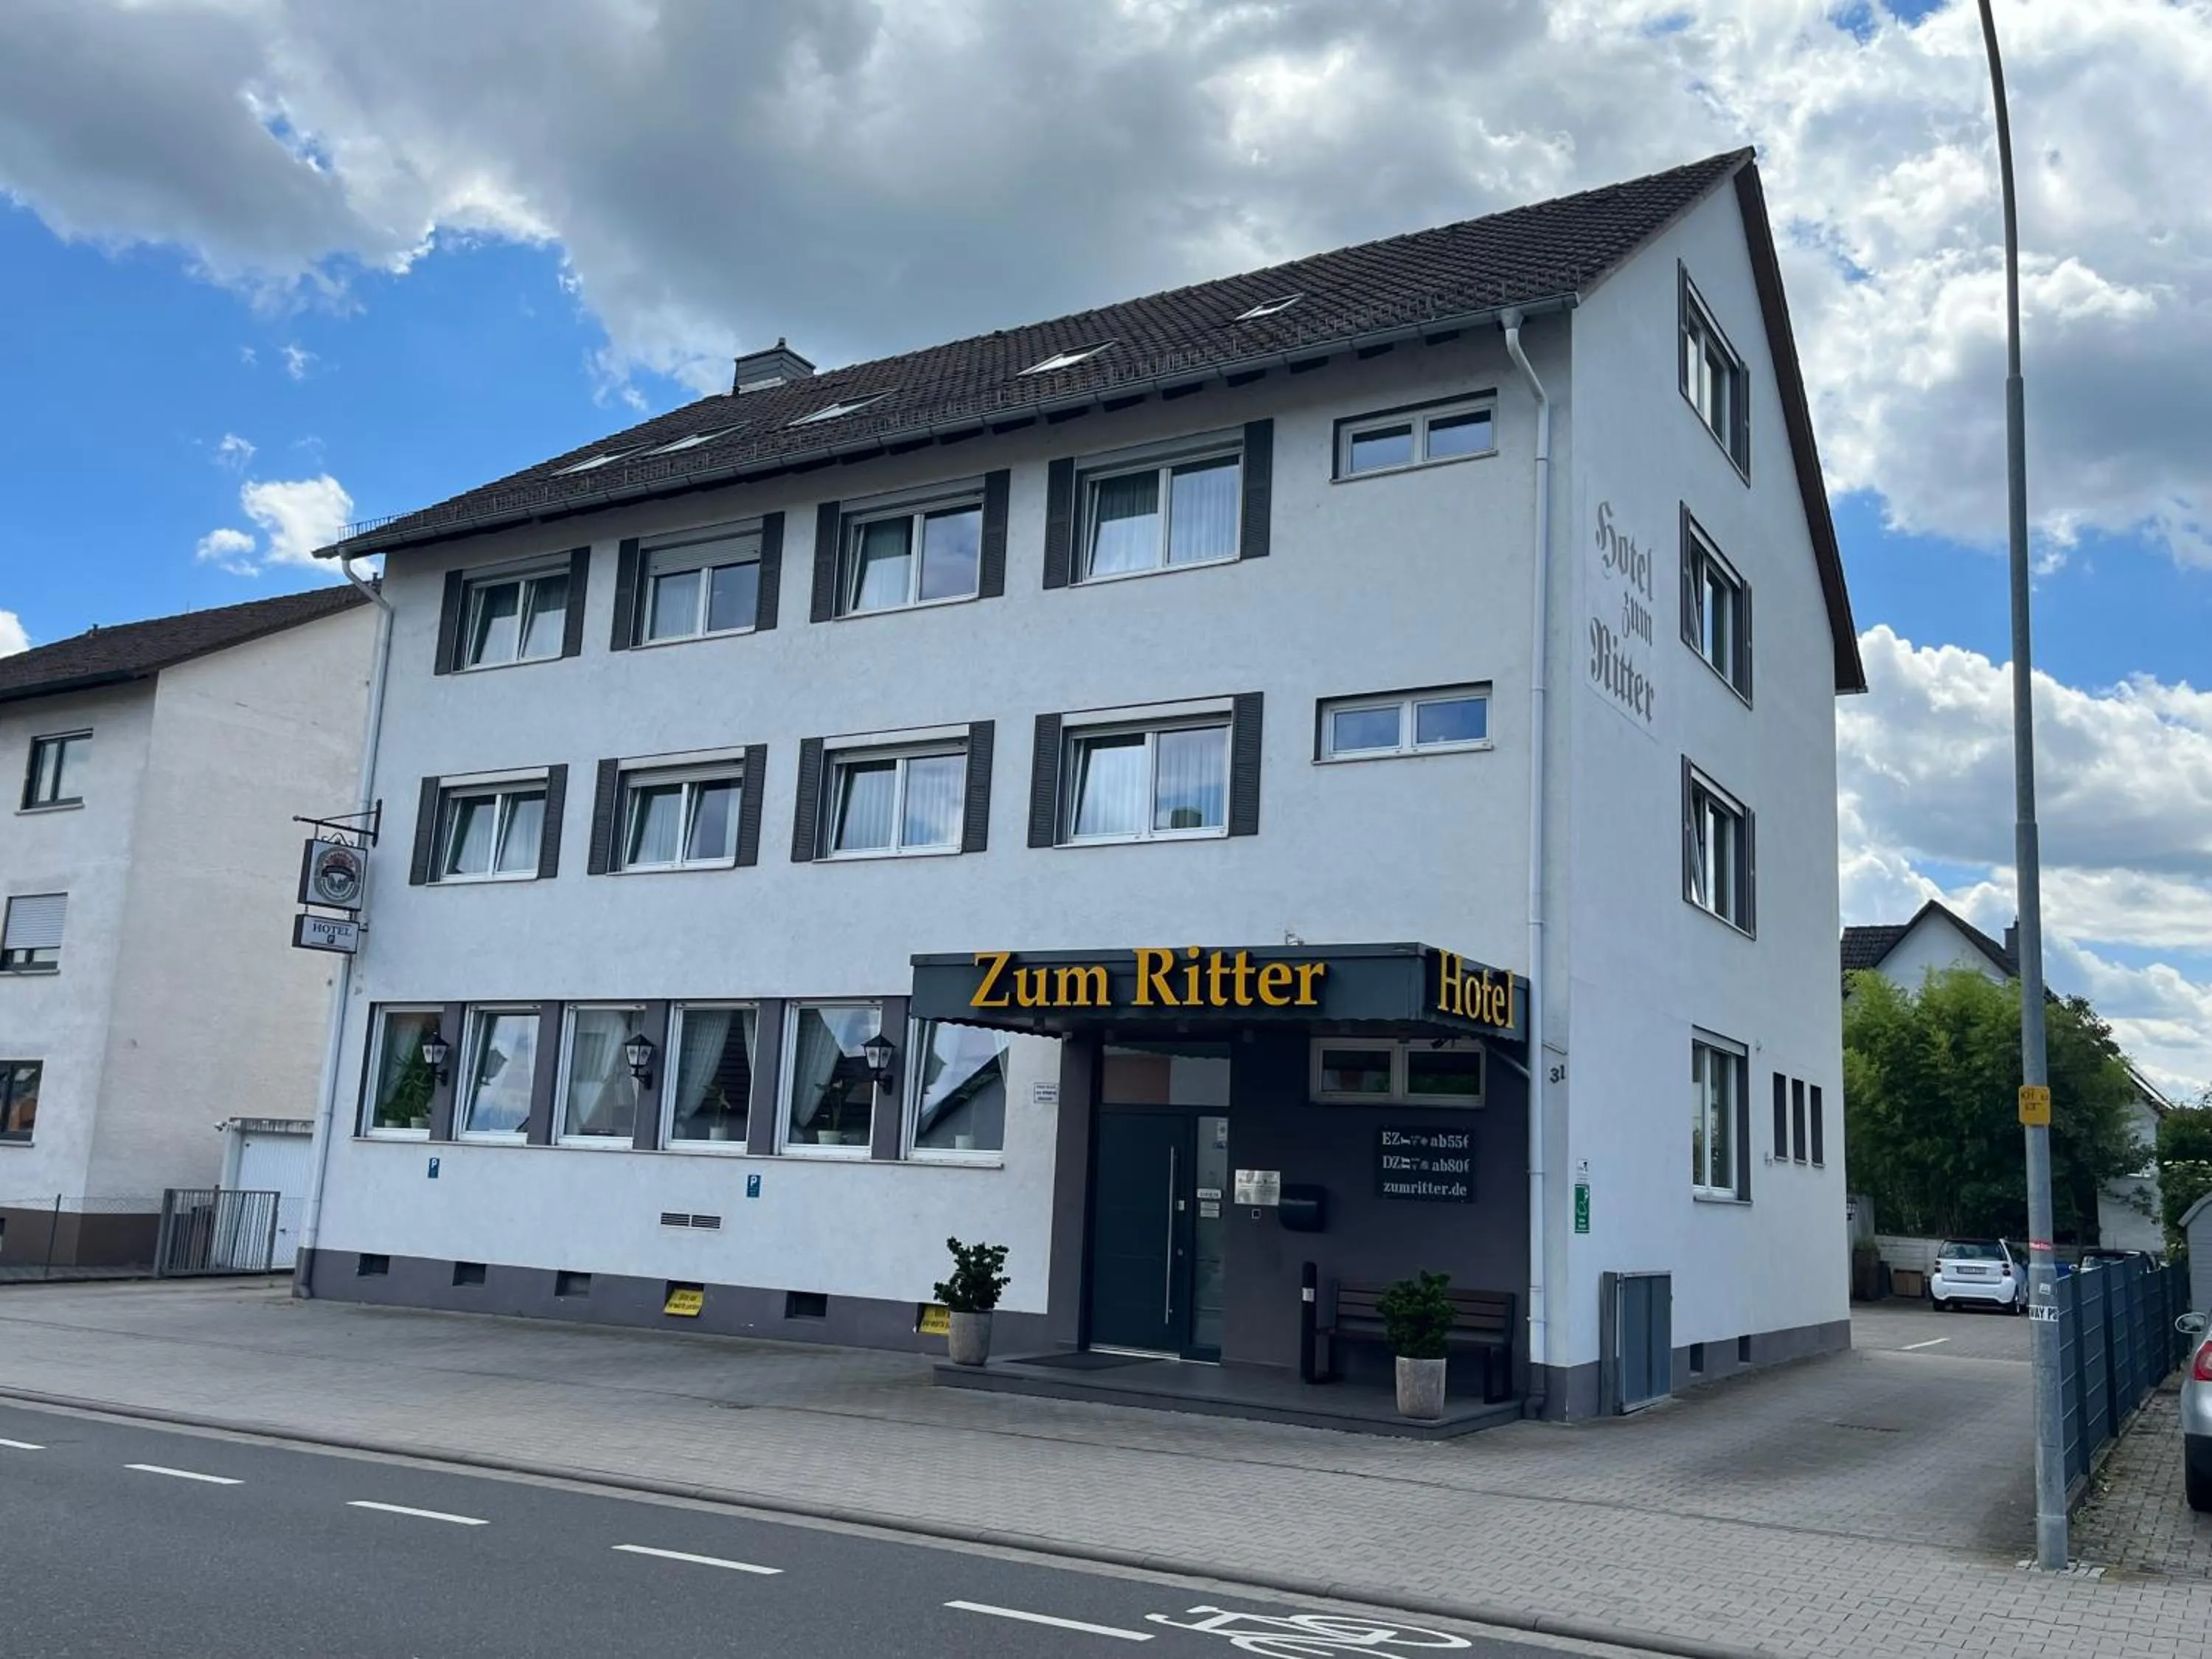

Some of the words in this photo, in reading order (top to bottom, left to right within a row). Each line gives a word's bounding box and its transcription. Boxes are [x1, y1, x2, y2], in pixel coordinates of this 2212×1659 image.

[1596, 501, 1653, 602] Hotel
[1590, 616, 1654, 723] Ritter
[313, 922, 352, 936] HOTEL
[969, 950, 1111, 1007] Zum
[1132, 945, 1325, 1006] Ritter
[1437, 949, 1515, 1029] Hotel
[1549, 1064, 1565, 1084] 31
[1382, 1131, 1401, 1145] EZ
[749, 1176, 757, 1187] P
[1382, 1180, 1467, 1196] zumritter.de
